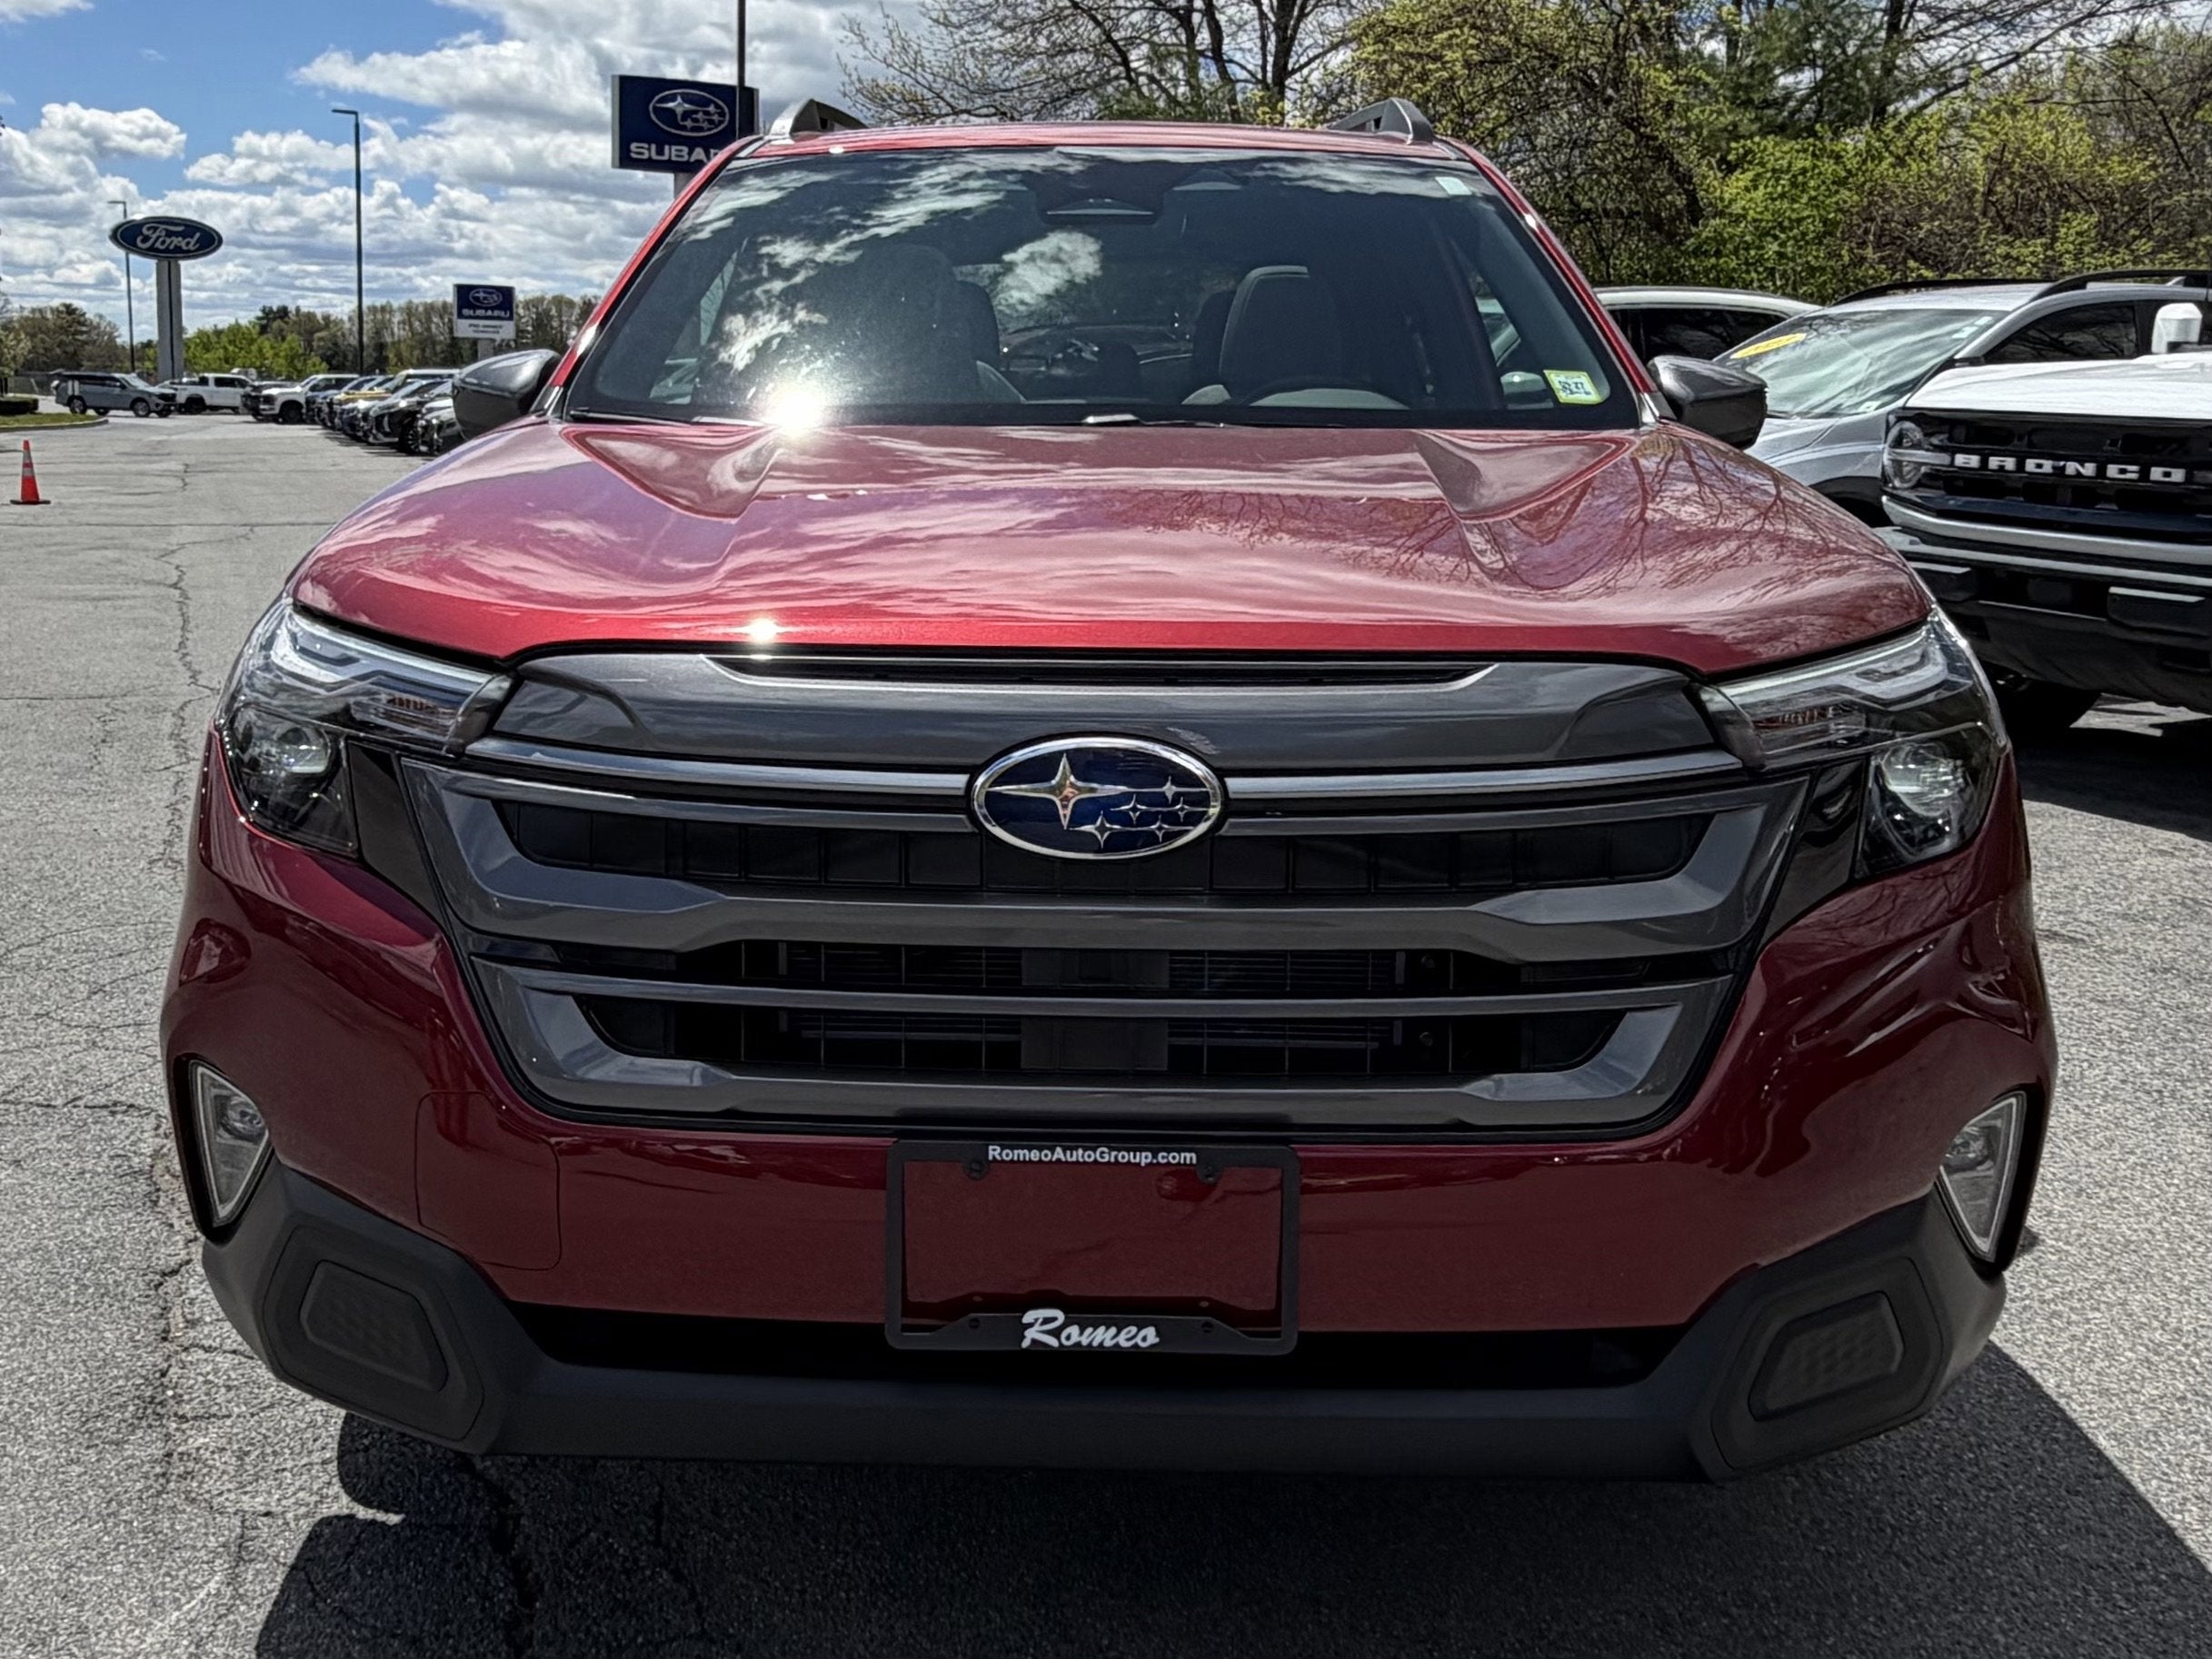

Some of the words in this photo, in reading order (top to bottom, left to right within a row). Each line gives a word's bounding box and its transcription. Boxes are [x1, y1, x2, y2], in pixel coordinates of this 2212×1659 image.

[630, 142, 721, 164] SUBA
[136, 223, 201, 251] Ford
[1954, 453, 2187, 483] BRONCO
[988, 1145, 1197, 1167] RomeoAutoGroup.com
[1021, 1308, 1161, 1349] Romeo
